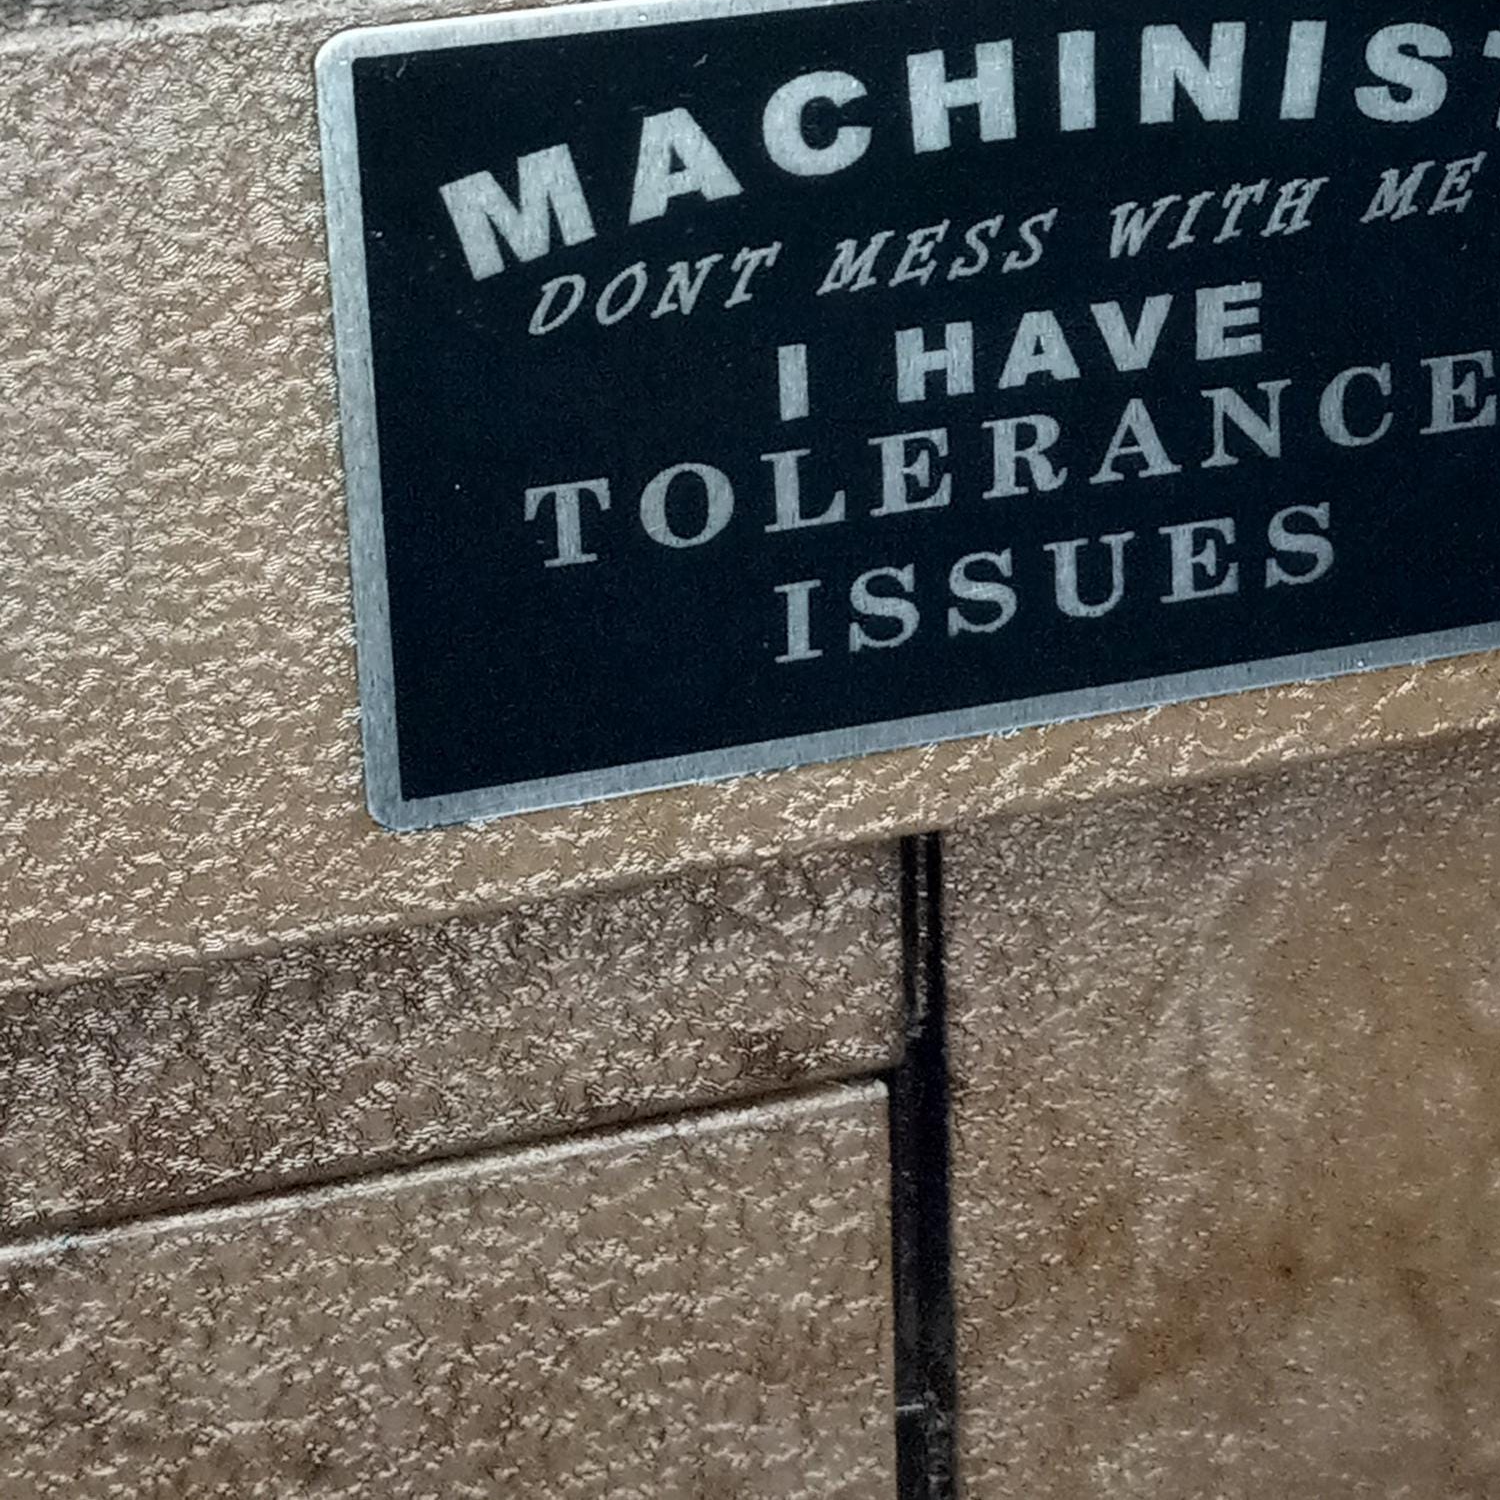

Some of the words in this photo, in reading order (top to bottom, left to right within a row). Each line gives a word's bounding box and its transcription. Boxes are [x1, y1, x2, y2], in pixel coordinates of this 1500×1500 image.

[527, 241, 782, 336] DONT
[815, 207, 1058, 296] MESS
[1107, 176, 1330, 259] WITH
[1359, 151, 1487, 224] ME
[777, 343, 810, 422] I
[895, 281, 1263, 403] HAVE
[523, 349, 1498, 568] TOLERANCE
[773, 501, 1335, 664] ISSUES
